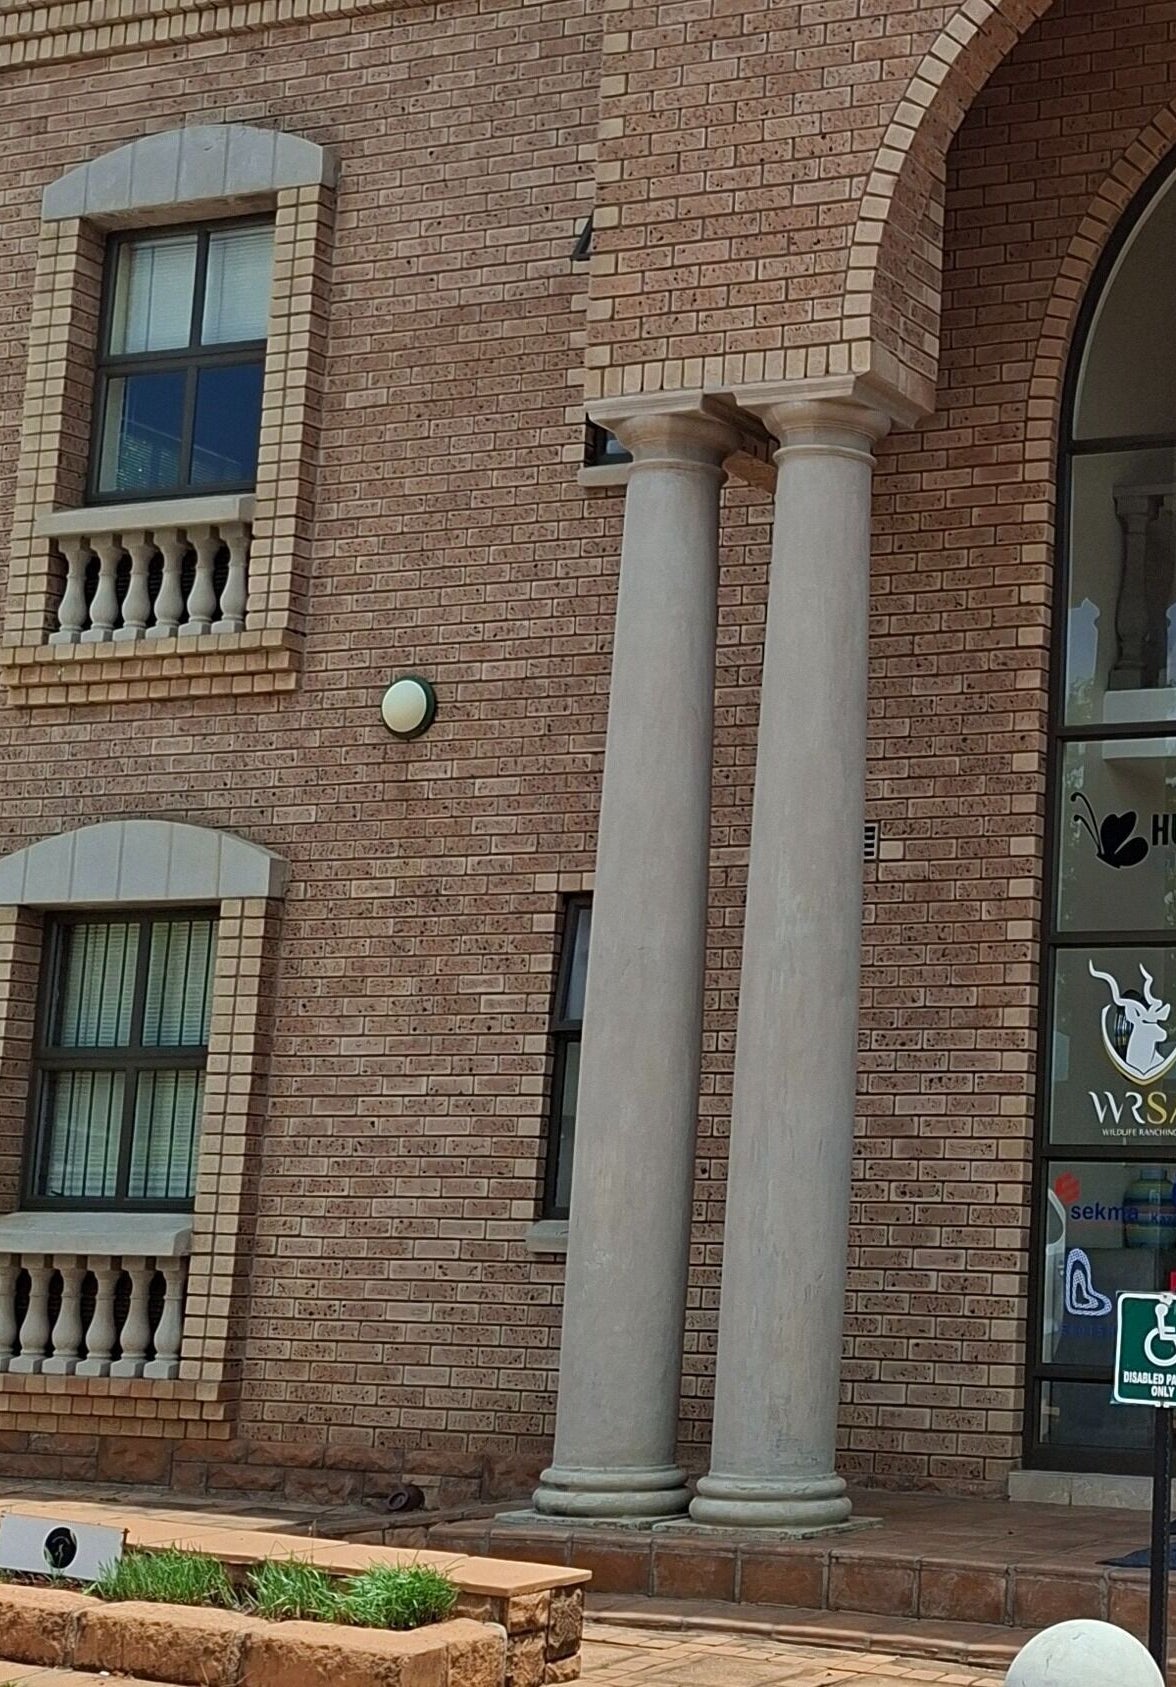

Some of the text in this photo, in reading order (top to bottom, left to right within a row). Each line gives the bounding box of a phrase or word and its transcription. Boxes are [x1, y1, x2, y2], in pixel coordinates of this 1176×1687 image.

[1102, 1128, 1137, 1136] WILDLIFE
[1123, 1371, 1164, 1385] DISABLED
[1151, 1386, 1175, 1398] ONLY
